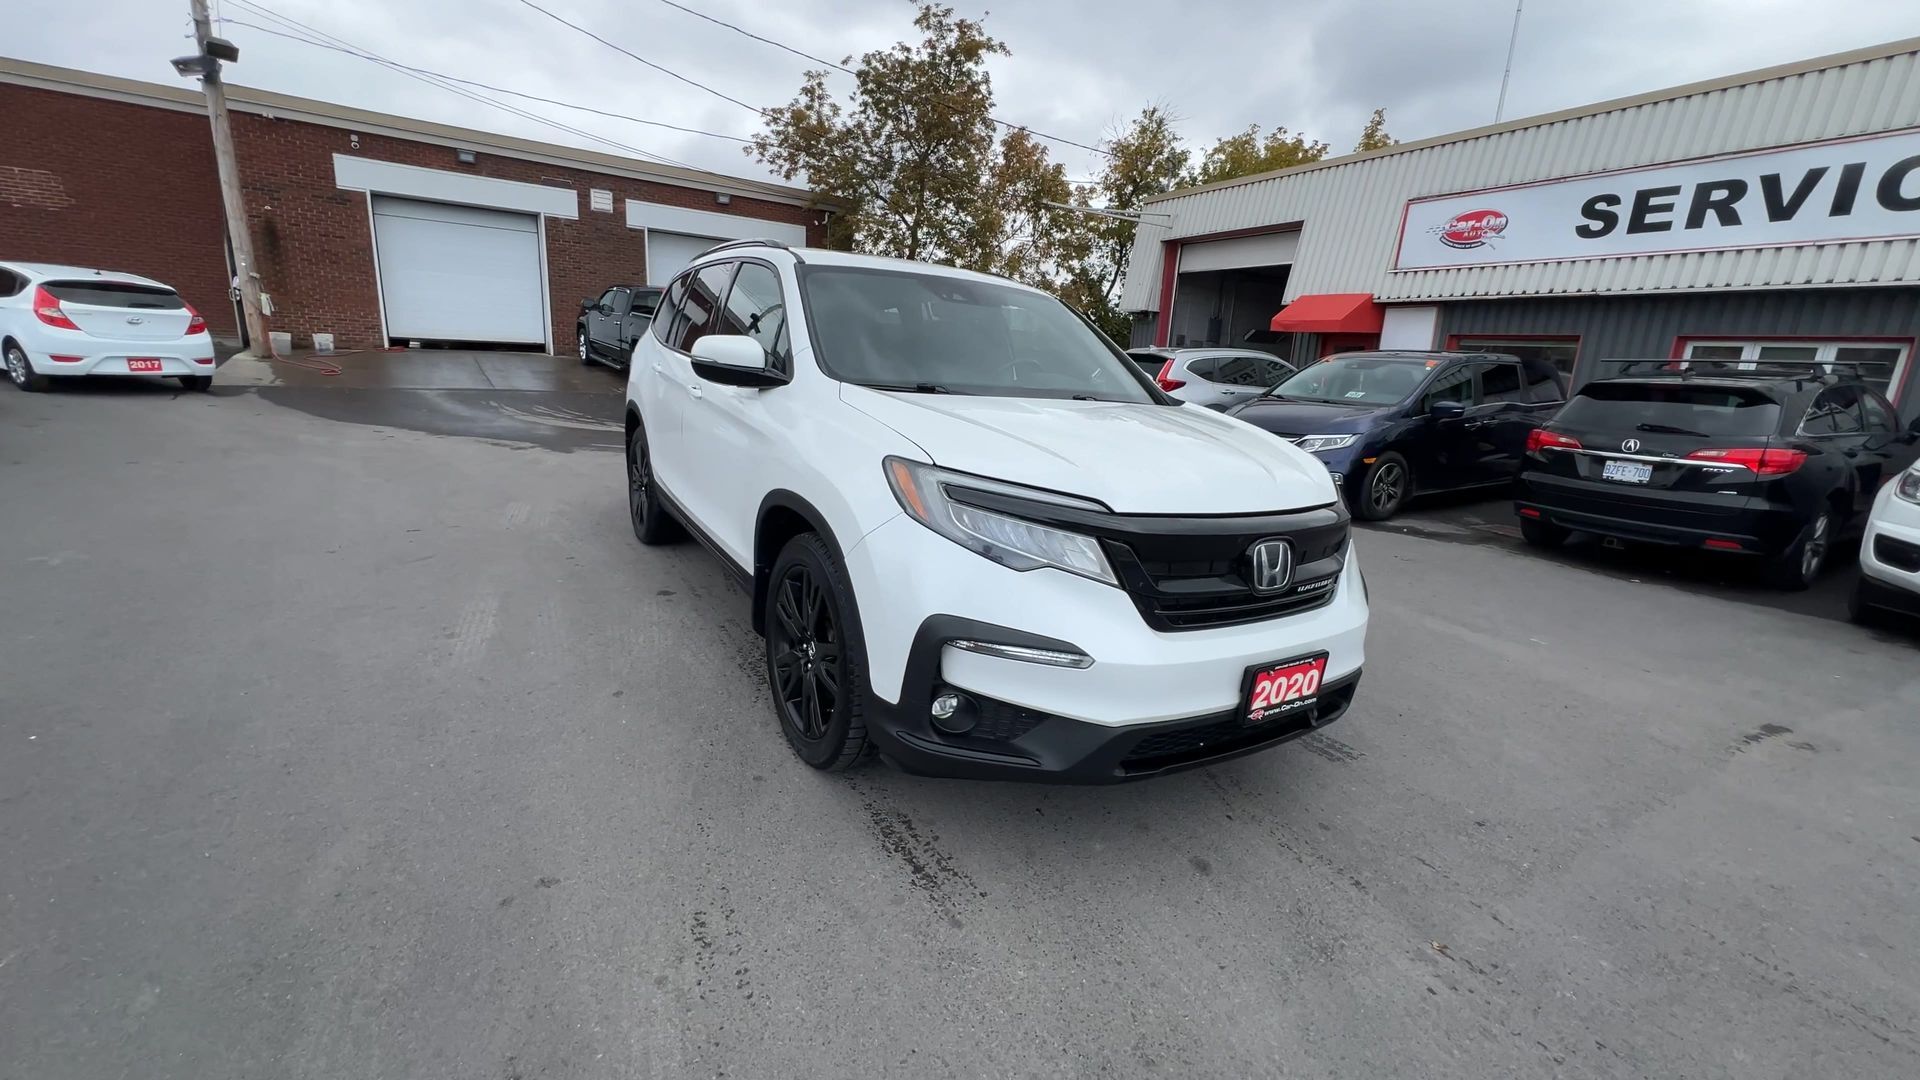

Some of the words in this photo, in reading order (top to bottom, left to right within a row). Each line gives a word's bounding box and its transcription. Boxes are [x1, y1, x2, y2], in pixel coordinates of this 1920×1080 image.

[1445, 215, 1507, 233] Car-On
[129, 360, 160, 369] 2017
[1251, 669, 1319, 710] 2020
